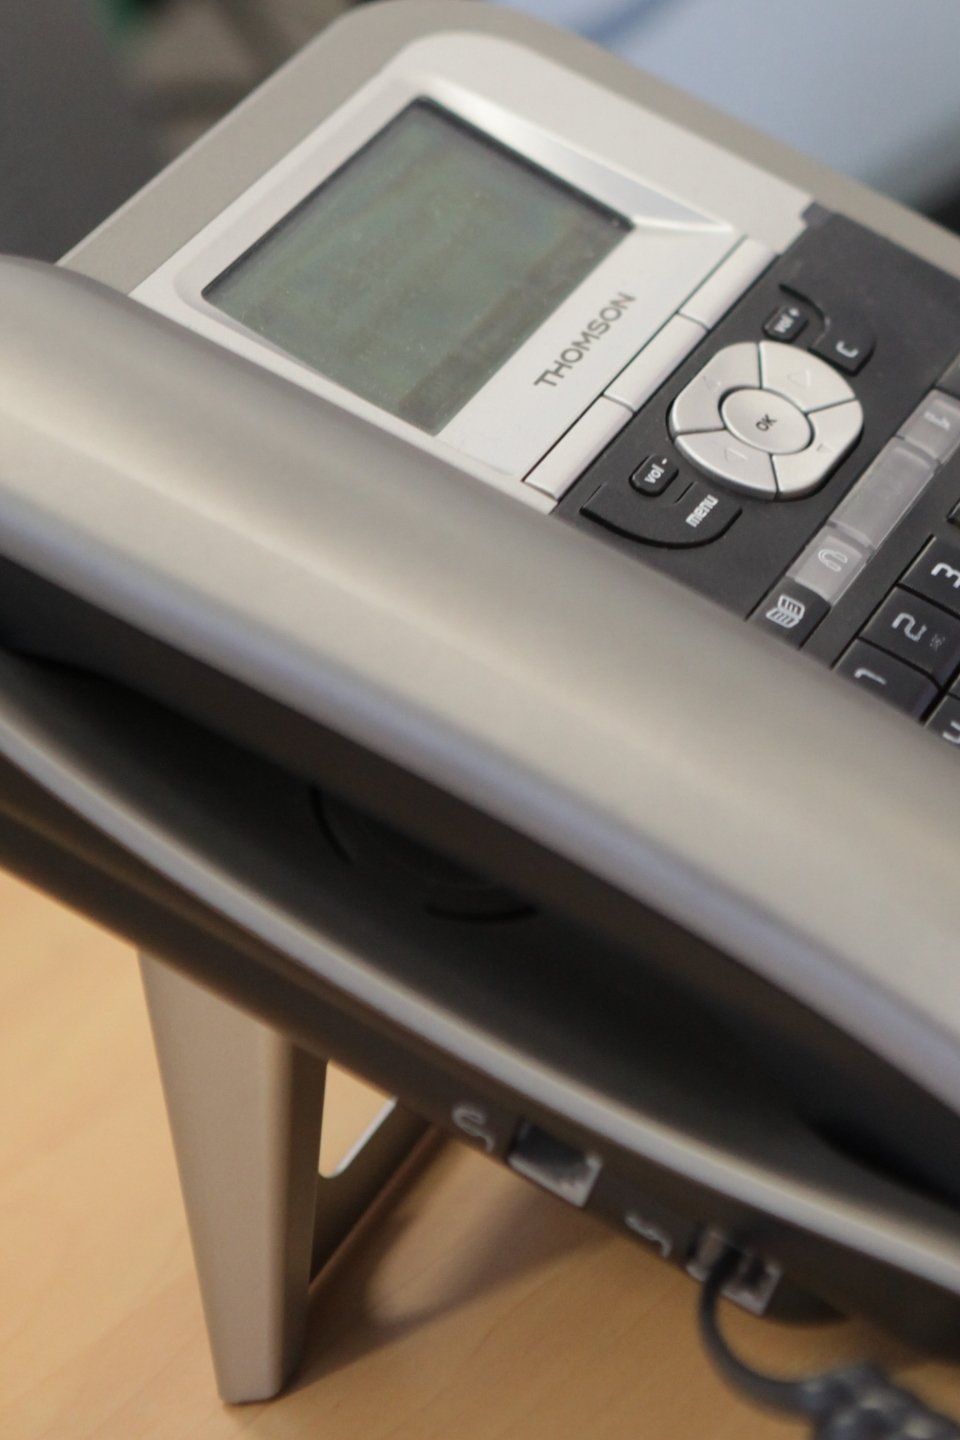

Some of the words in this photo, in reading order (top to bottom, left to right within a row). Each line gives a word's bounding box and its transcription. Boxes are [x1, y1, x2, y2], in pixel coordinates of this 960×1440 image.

[533, 292, 636, 387] THOMSON
[755, 413, 778, 432] OK
[644, 463, 665, 484] vol
[685, 494, 719, 528] menu
[891, 612, 927, 642] 2
[854, 667, 887, 685] 1
